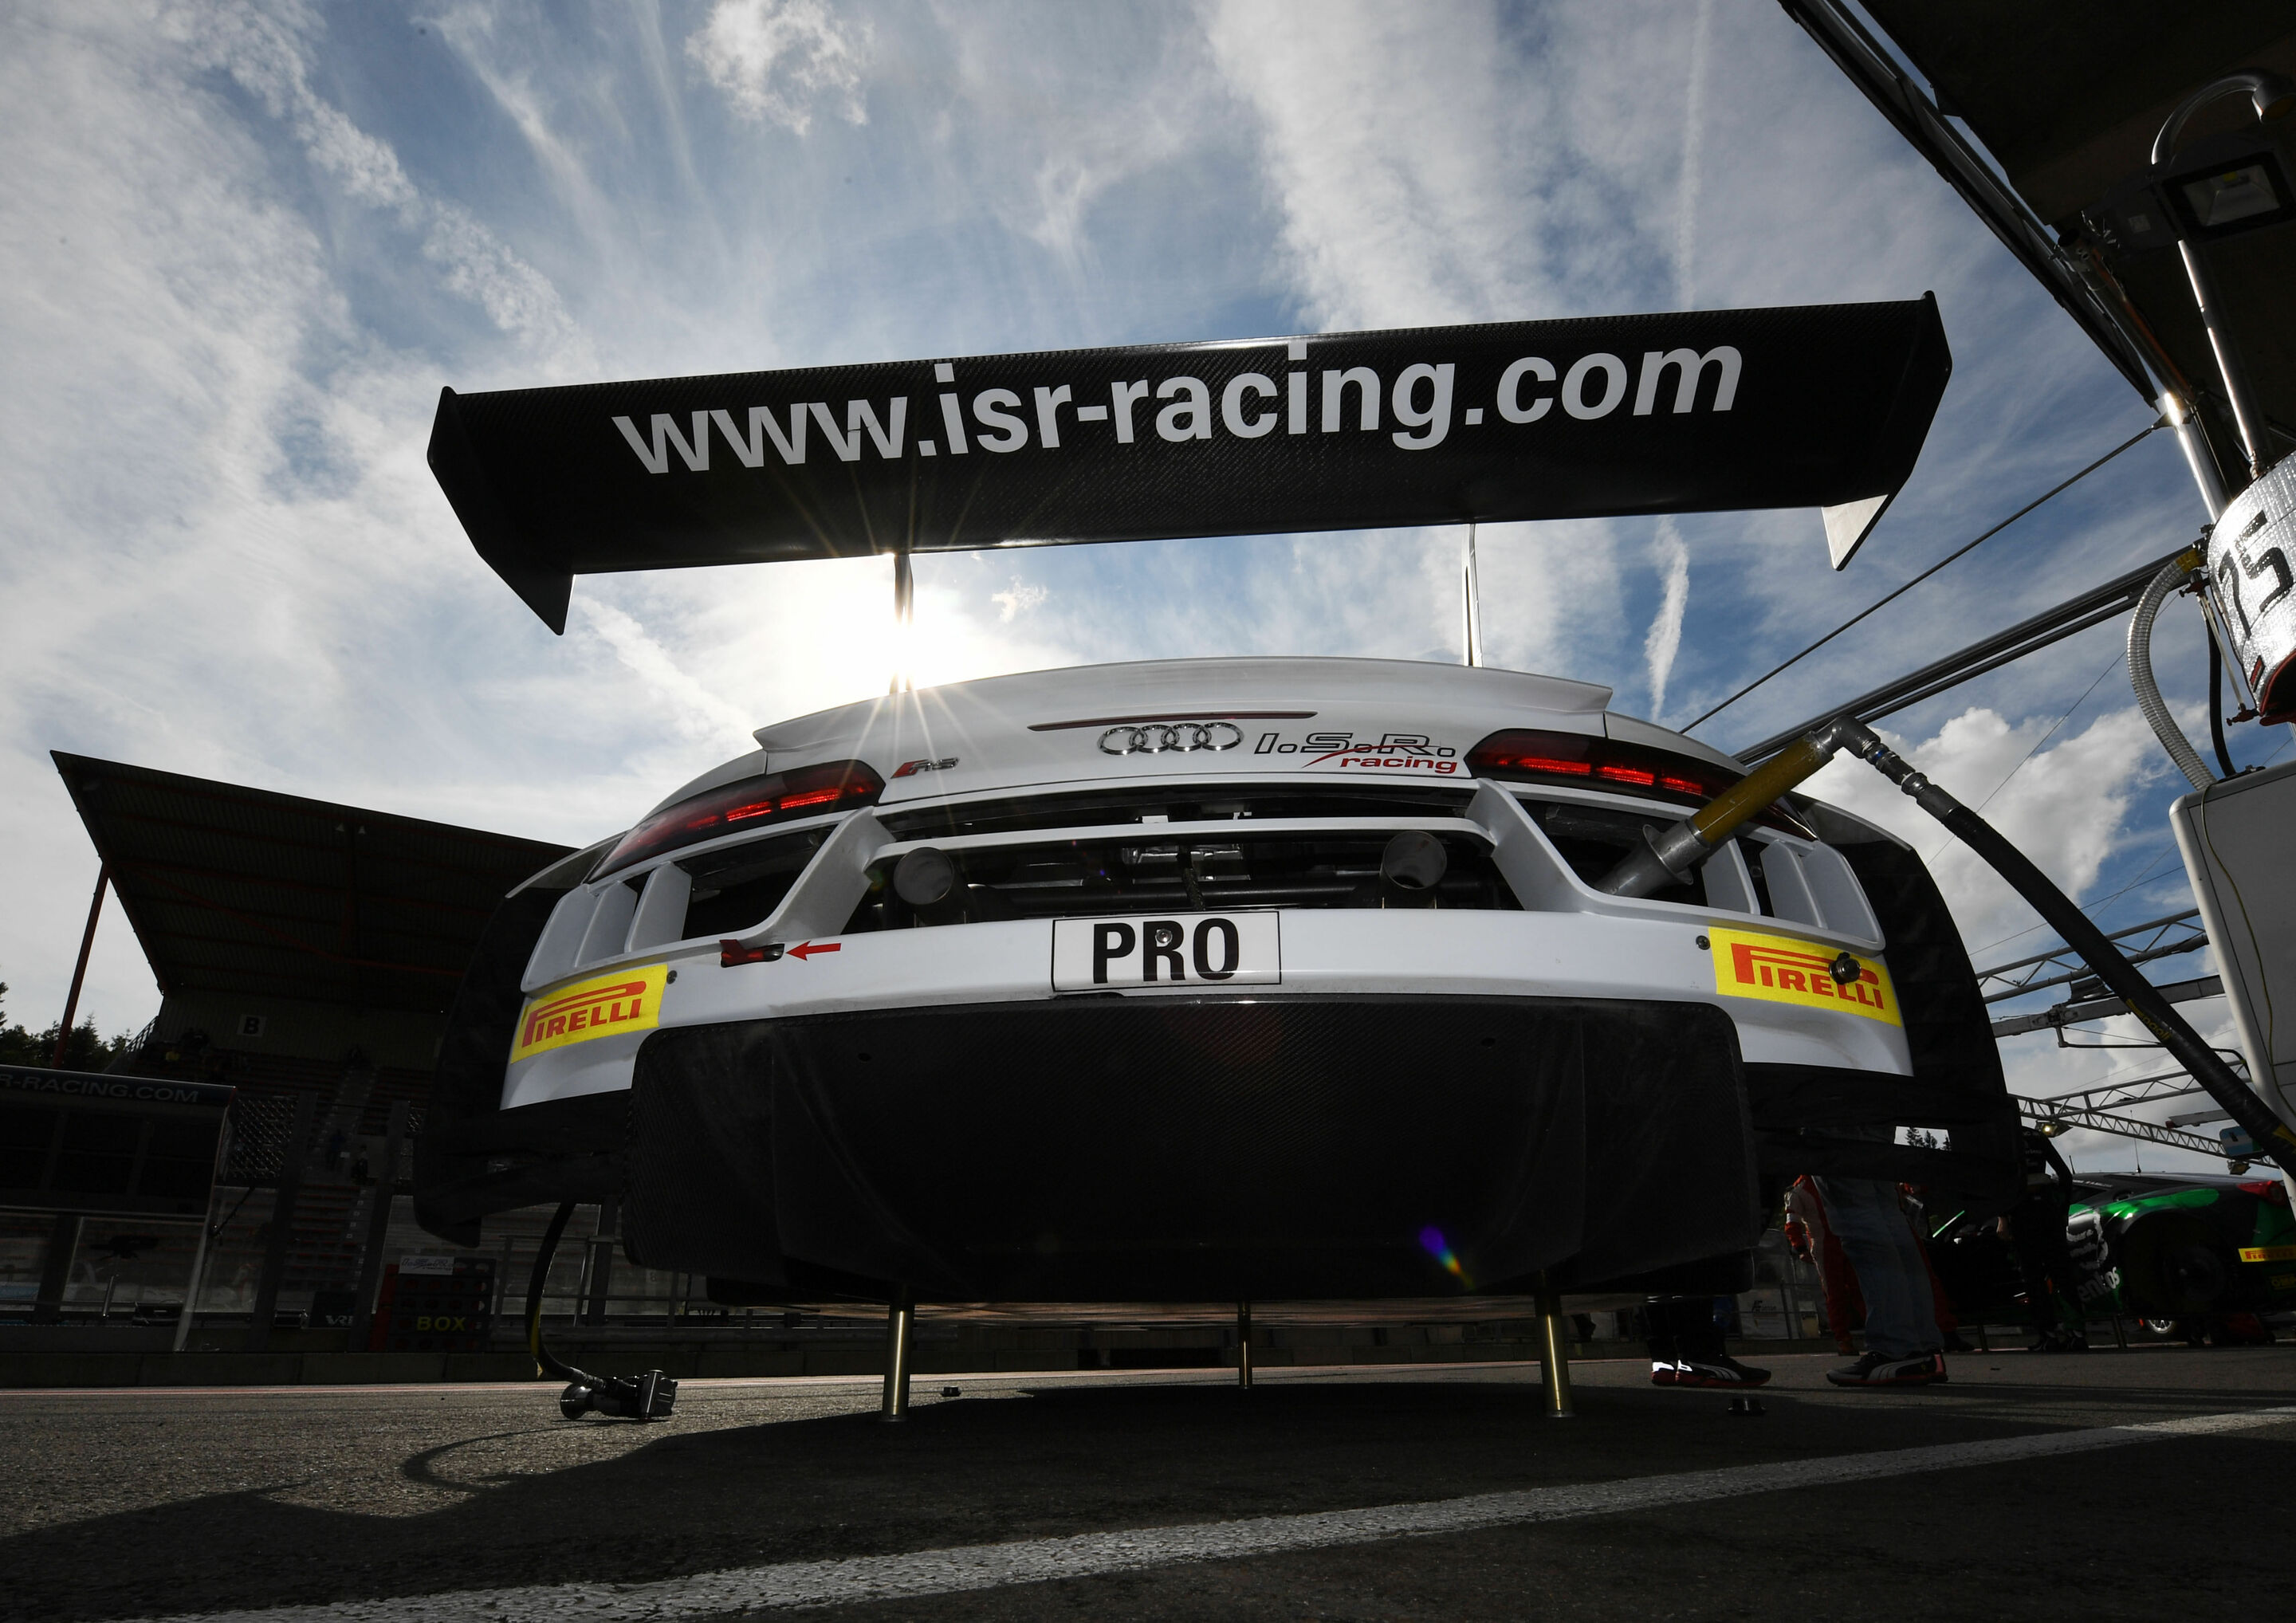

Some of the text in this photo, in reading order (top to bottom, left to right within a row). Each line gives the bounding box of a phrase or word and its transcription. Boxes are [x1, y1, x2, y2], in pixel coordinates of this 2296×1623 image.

[611, 342, 1743, 474] www.isr-racing.com
[1339, 756, 1457, 773] racing
[1093, 918, 1239, 984] PRO
[1731, 943, 1884, 1010] PIRELLI
[243, 1017, 259, 1034] B
[521, 980, 647, 1048] PIRELLI
[415, 1316, 466, 1332] BOX
